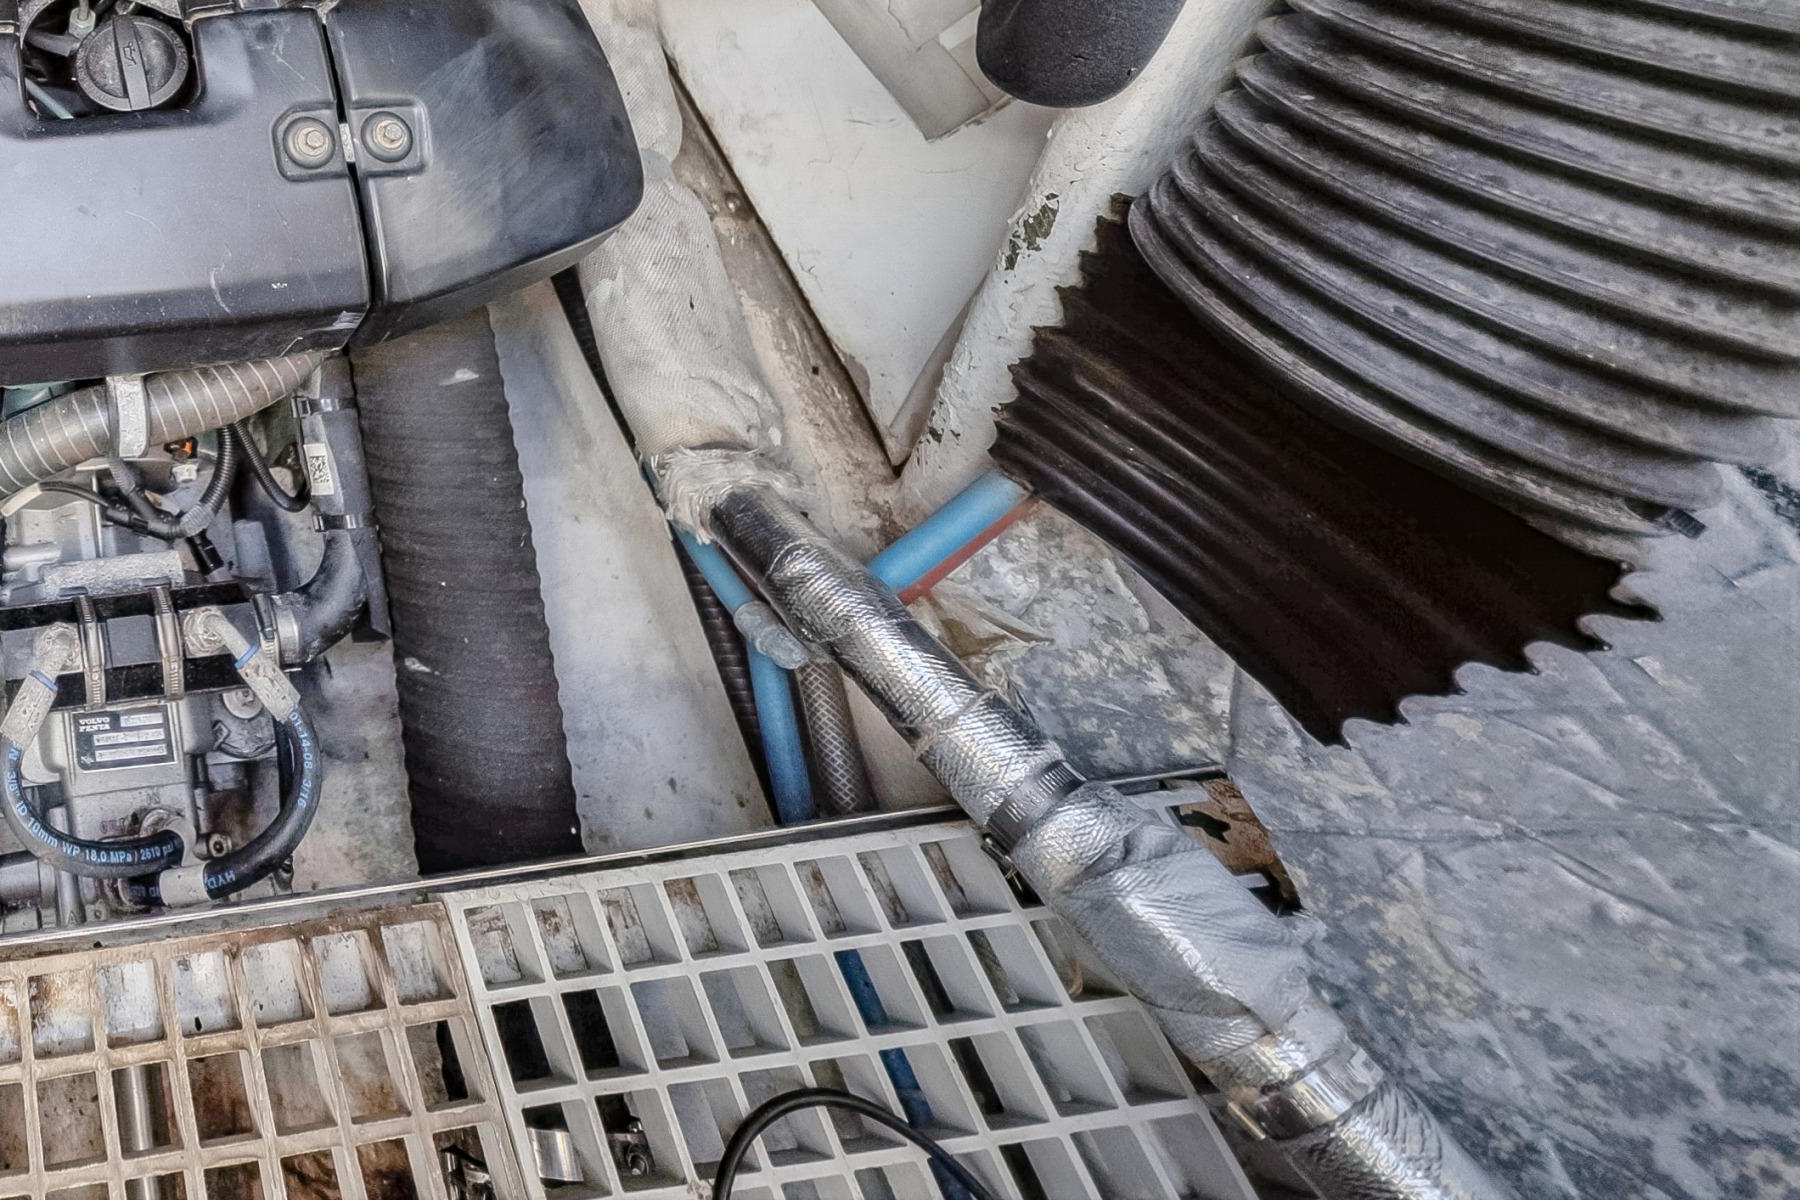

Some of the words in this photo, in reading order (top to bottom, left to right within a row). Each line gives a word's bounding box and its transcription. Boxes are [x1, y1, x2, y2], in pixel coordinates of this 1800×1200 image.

[79, 717, 111, 725] VOLVO
[79, 724, 112, 732] PENTA
[16, 800, 28, 816] ID
[27, 817, 59, 848] 10mm
[62, 841, 80, 856] WP
[206, 869, 236, 889] HYD
